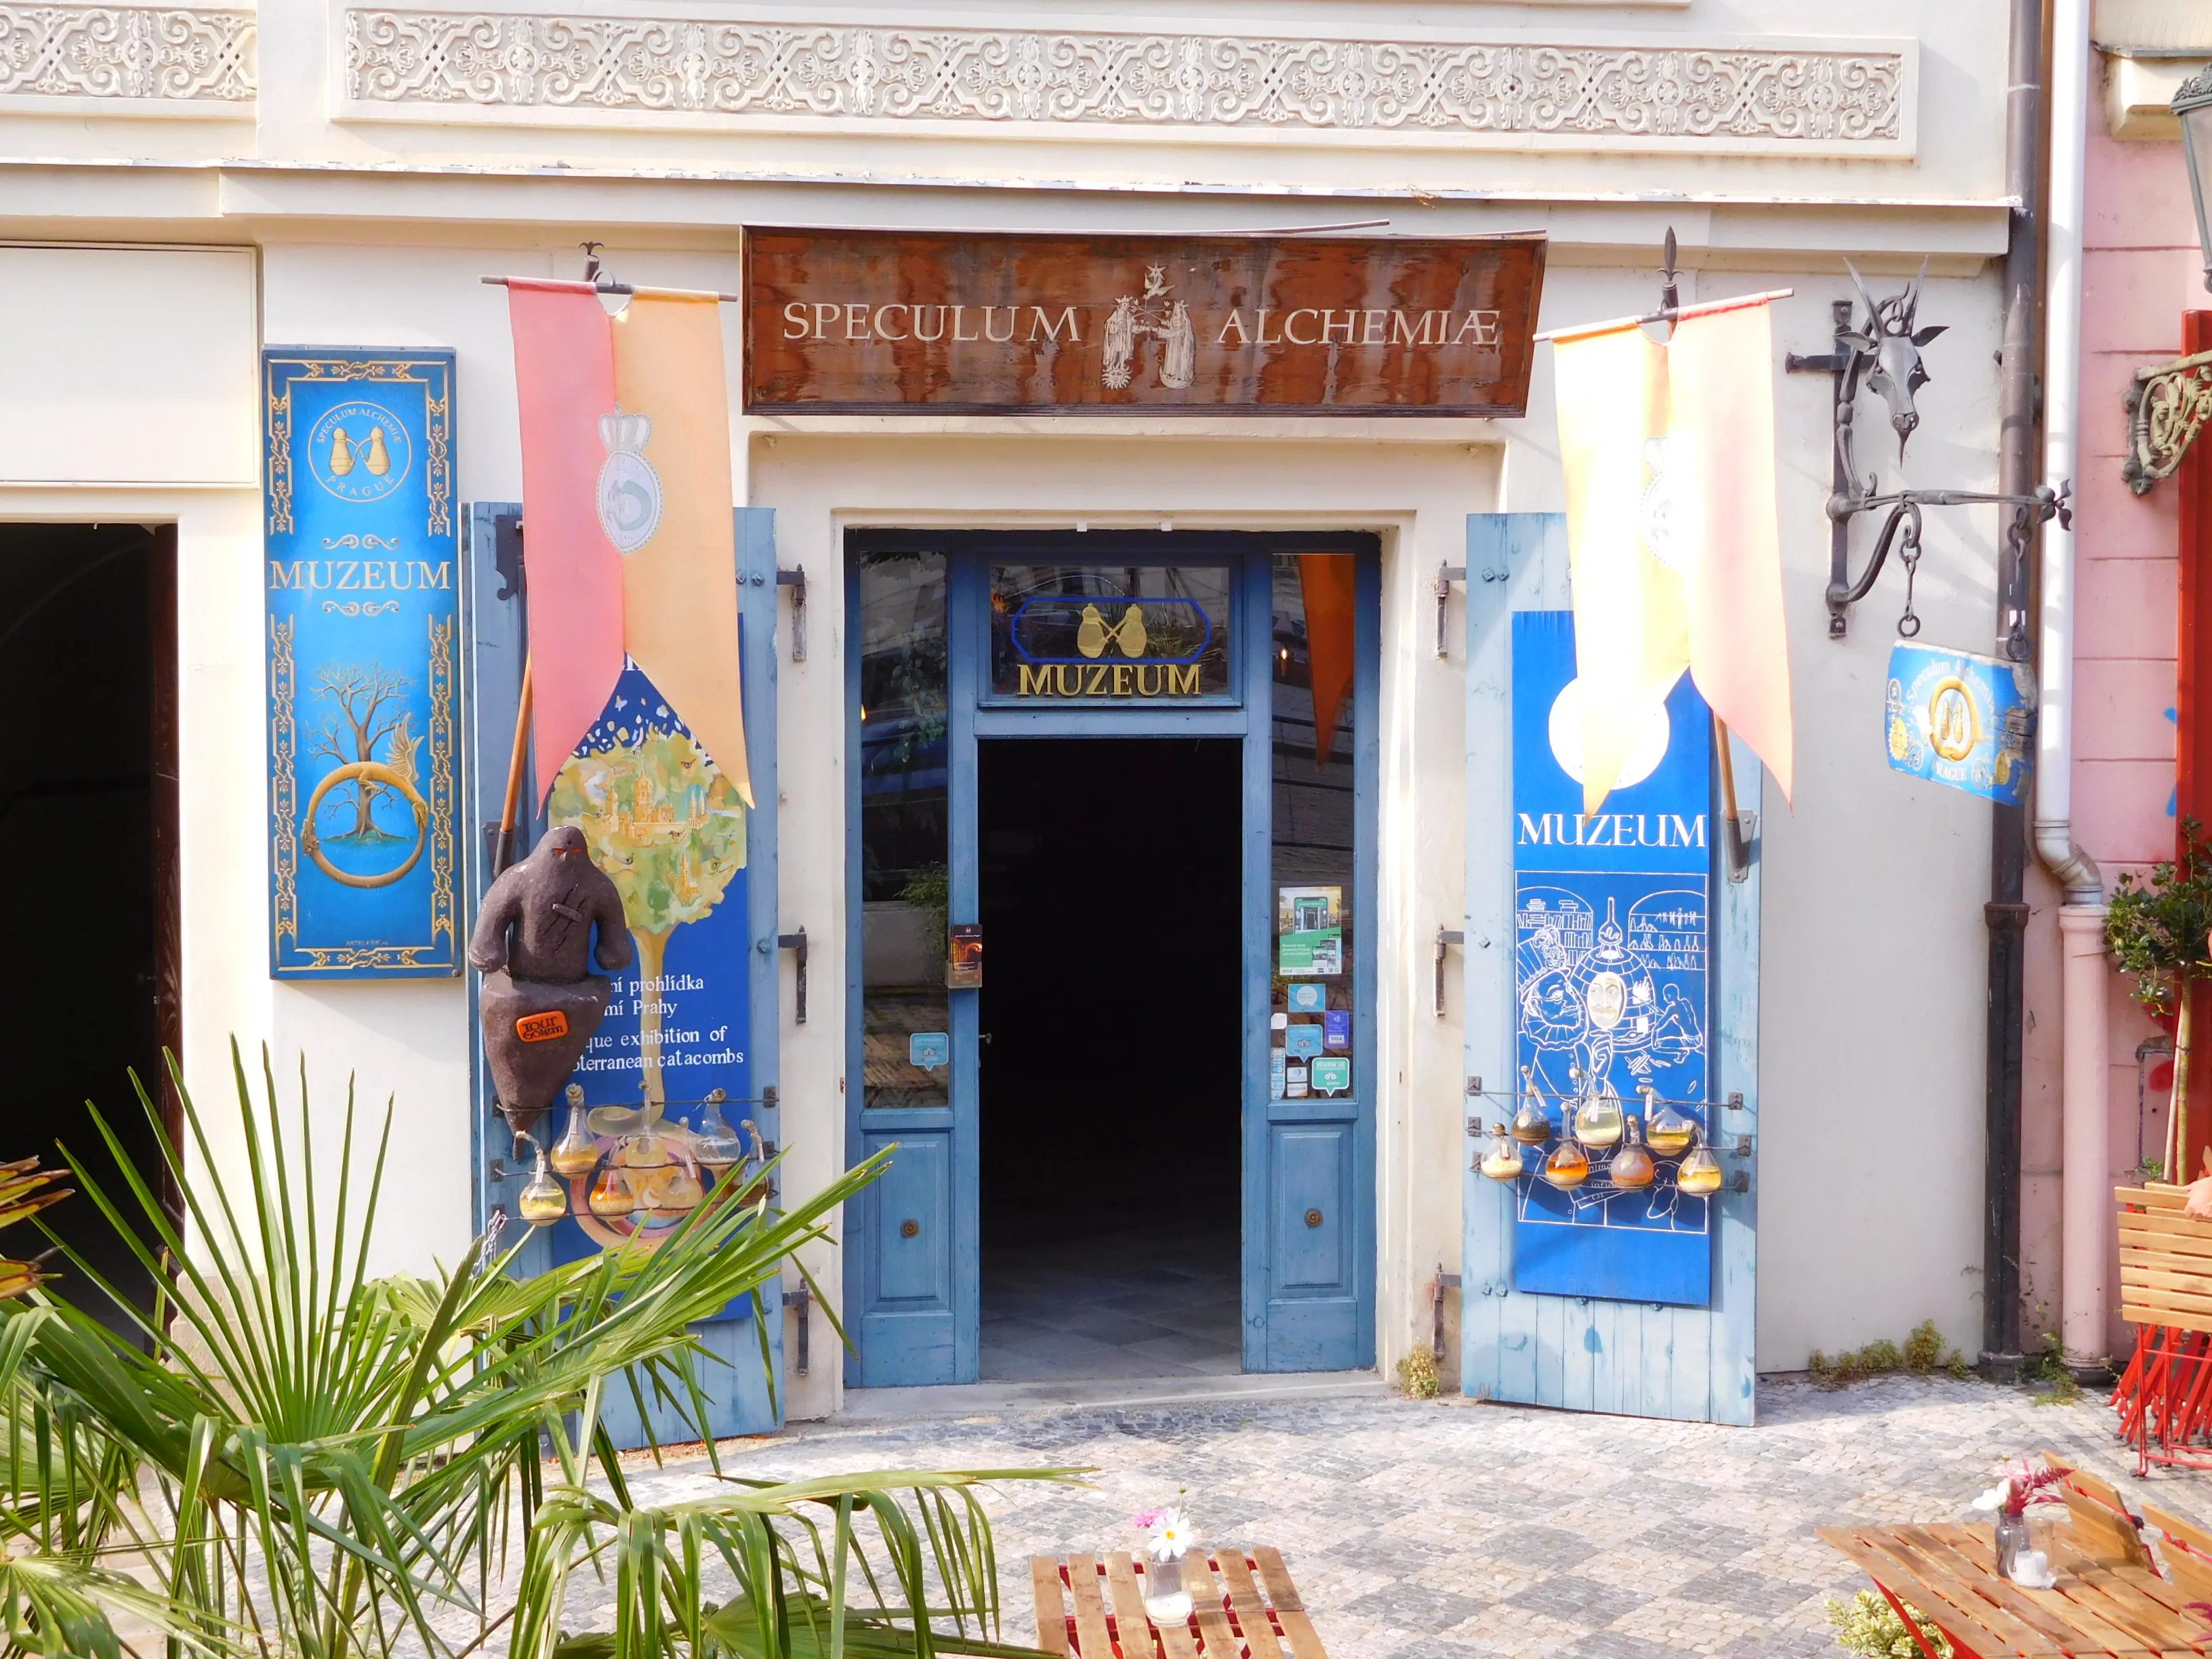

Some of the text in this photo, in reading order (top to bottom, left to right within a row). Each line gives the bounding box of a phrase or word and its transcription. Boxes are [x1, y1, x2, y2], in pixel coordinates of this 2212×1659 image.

[783, 302, 1500, 345] SPECULUM ALCHEMIÆ
[317, 408, 357, 444] SPECULUM
[327, 474, 394, 495] PRAGUE
[269, 560, 451, 590] MUZEUM
[1017, 664, 1202, 696] MUZEUM
[1517, 813, 1706, 847] MUZEUM
[611, 974, 703, 996] ní prohlídka
[604, 999, 678, 1018] mí Prahy
[621, 1027, 699, 1046] exhibition
[710, 1025, 728, 1042] of
[573, 1048, 743, 1071] terranean catacombs
